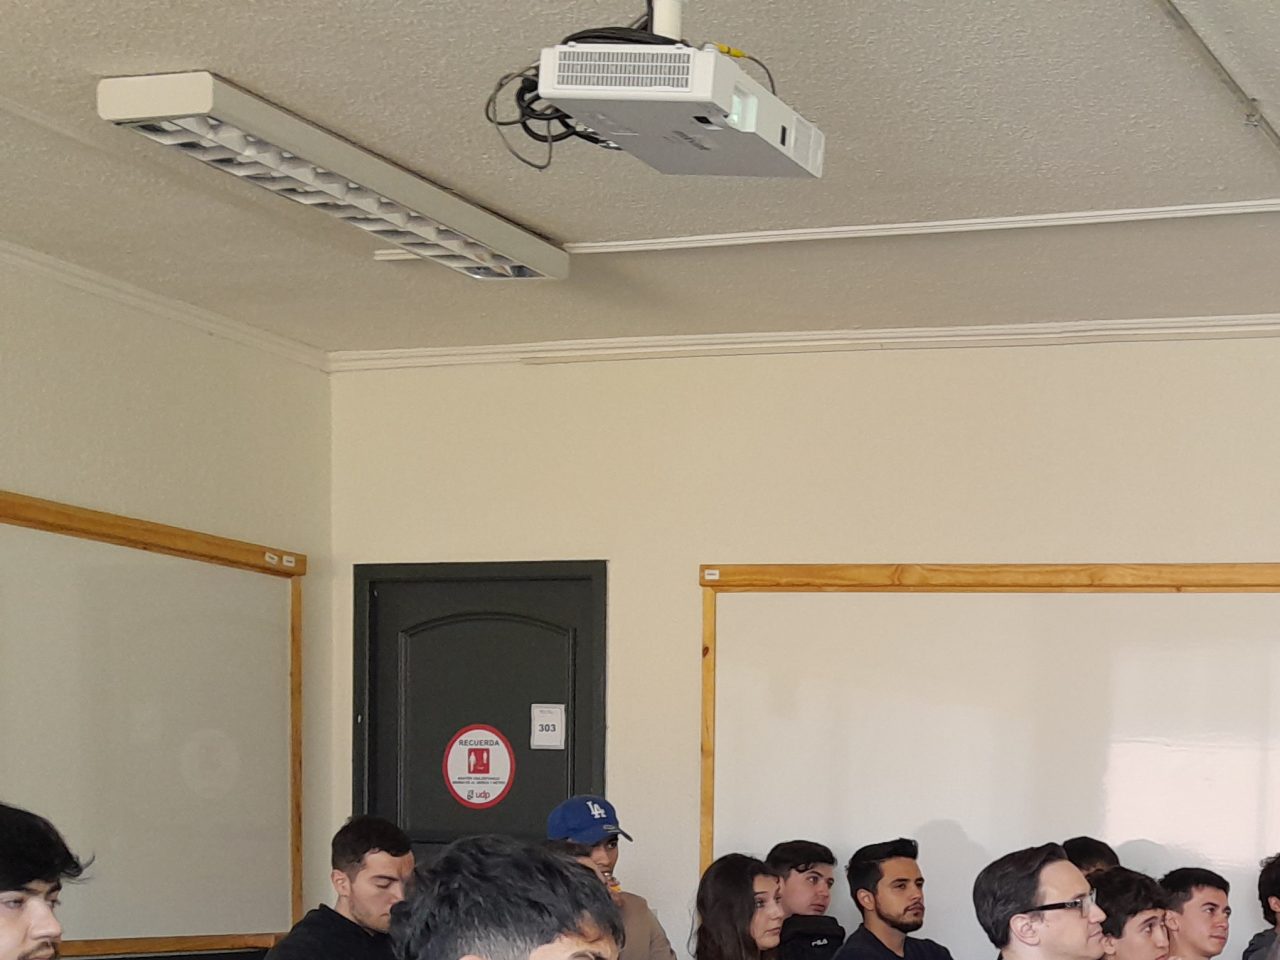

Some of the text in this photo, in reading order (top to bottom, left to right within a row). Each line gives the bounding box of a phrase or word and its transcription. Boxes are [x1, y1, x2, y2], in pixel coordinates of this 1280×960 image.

[538, 723, 556, 732] 303
[458, 739, 500, 747] RECUERDA
[475, 790, 491, 800] udp
[586, 800, 607, 819] LA
